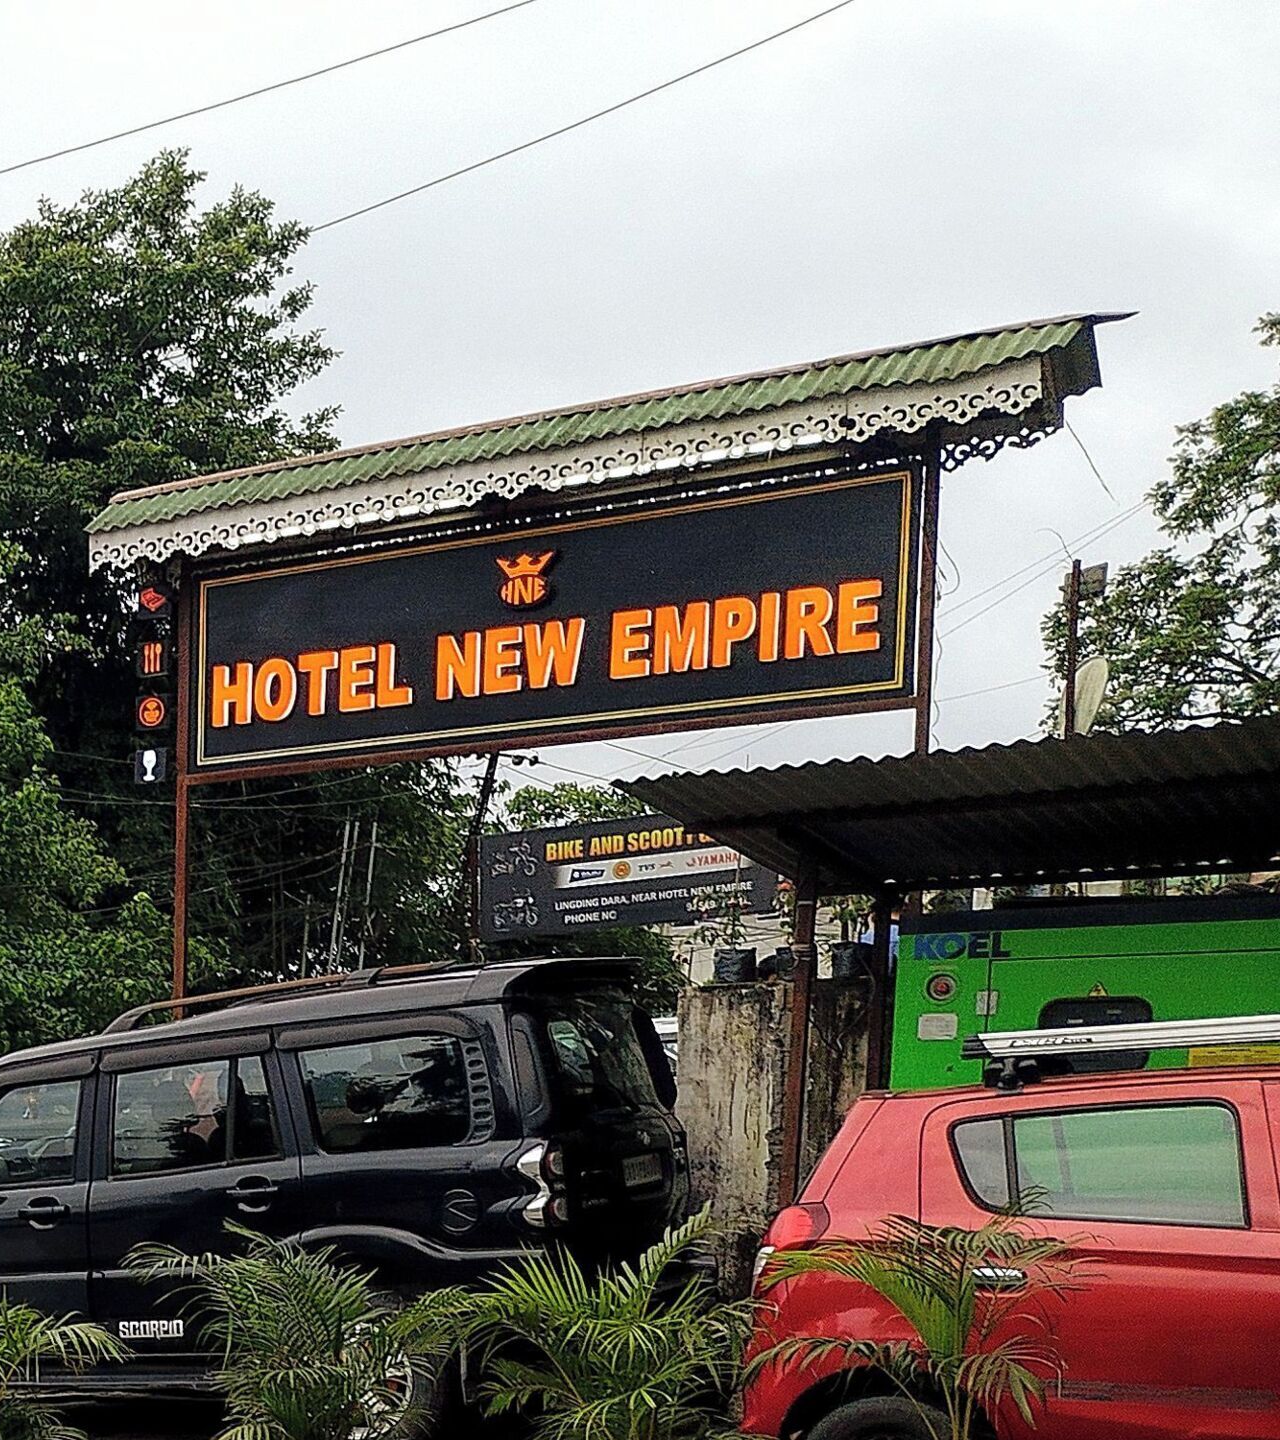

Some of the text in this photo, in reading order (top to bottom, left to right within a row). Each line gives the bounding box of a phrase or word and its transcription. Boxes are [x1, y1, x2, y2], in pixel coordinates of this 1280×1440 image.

[500, 575, 547, 605] HNE
[210, 577, 883, 728] HOTEL NEW EMPIRE
[546, 838, 583, 862] BIKE
[589, 833, 625, 856] AND
[697, 852, 738, 867] YAMAHA
[631, 891, 657, 903] NEAR
[658, 888, 690, 900] HOTEL
[564, 911, 600, 924] PHONE
[914, 931, 1012, 960] KOEL
[118, 1318, 184, 1341] SCORPIO
